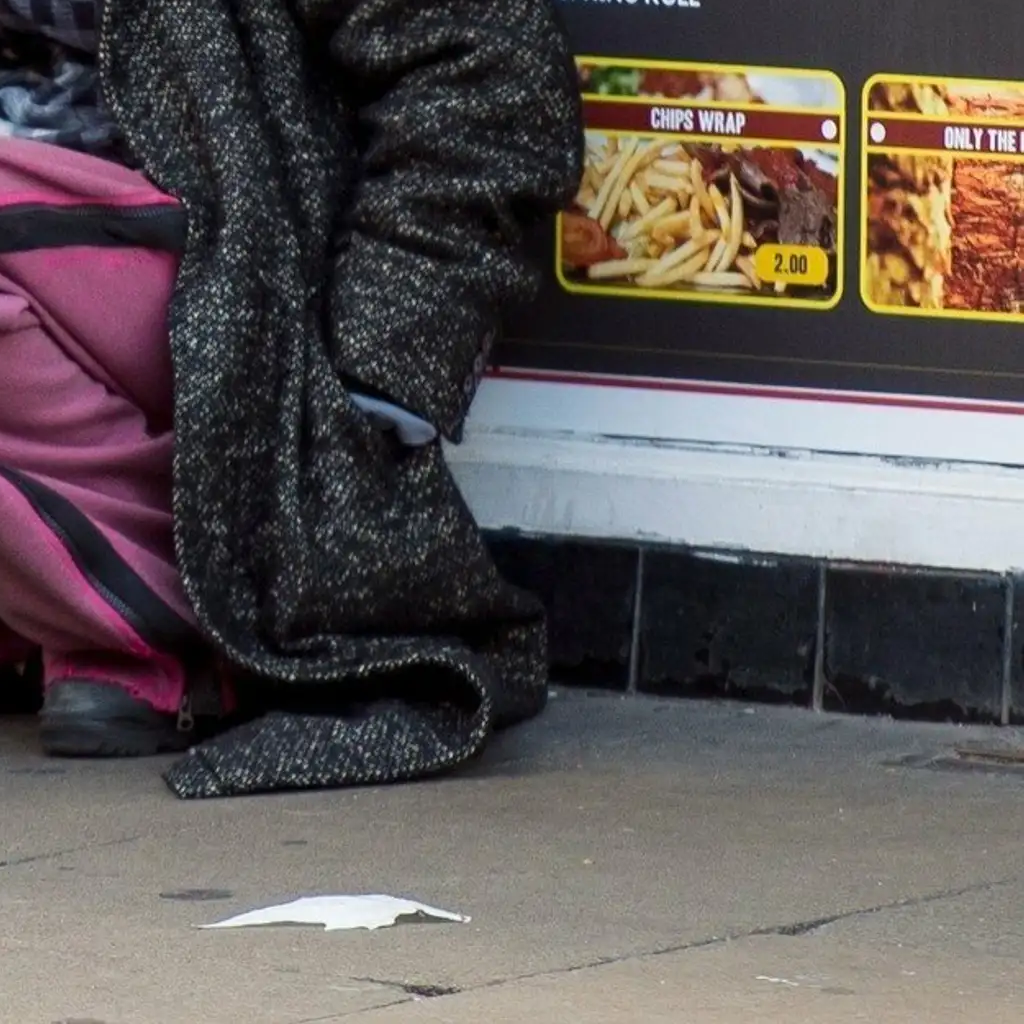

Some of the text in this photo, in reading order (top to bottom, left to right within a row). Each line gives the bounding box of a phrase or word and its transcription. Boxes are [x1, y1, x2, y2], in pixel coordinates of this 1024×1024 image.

[651, 107, 746, 134] CHIPS WRAP
[944, 126, 984, 150] ONLY
[987, 128, 1017, 153] THE
[773, 253, 809, 275] 2.00
